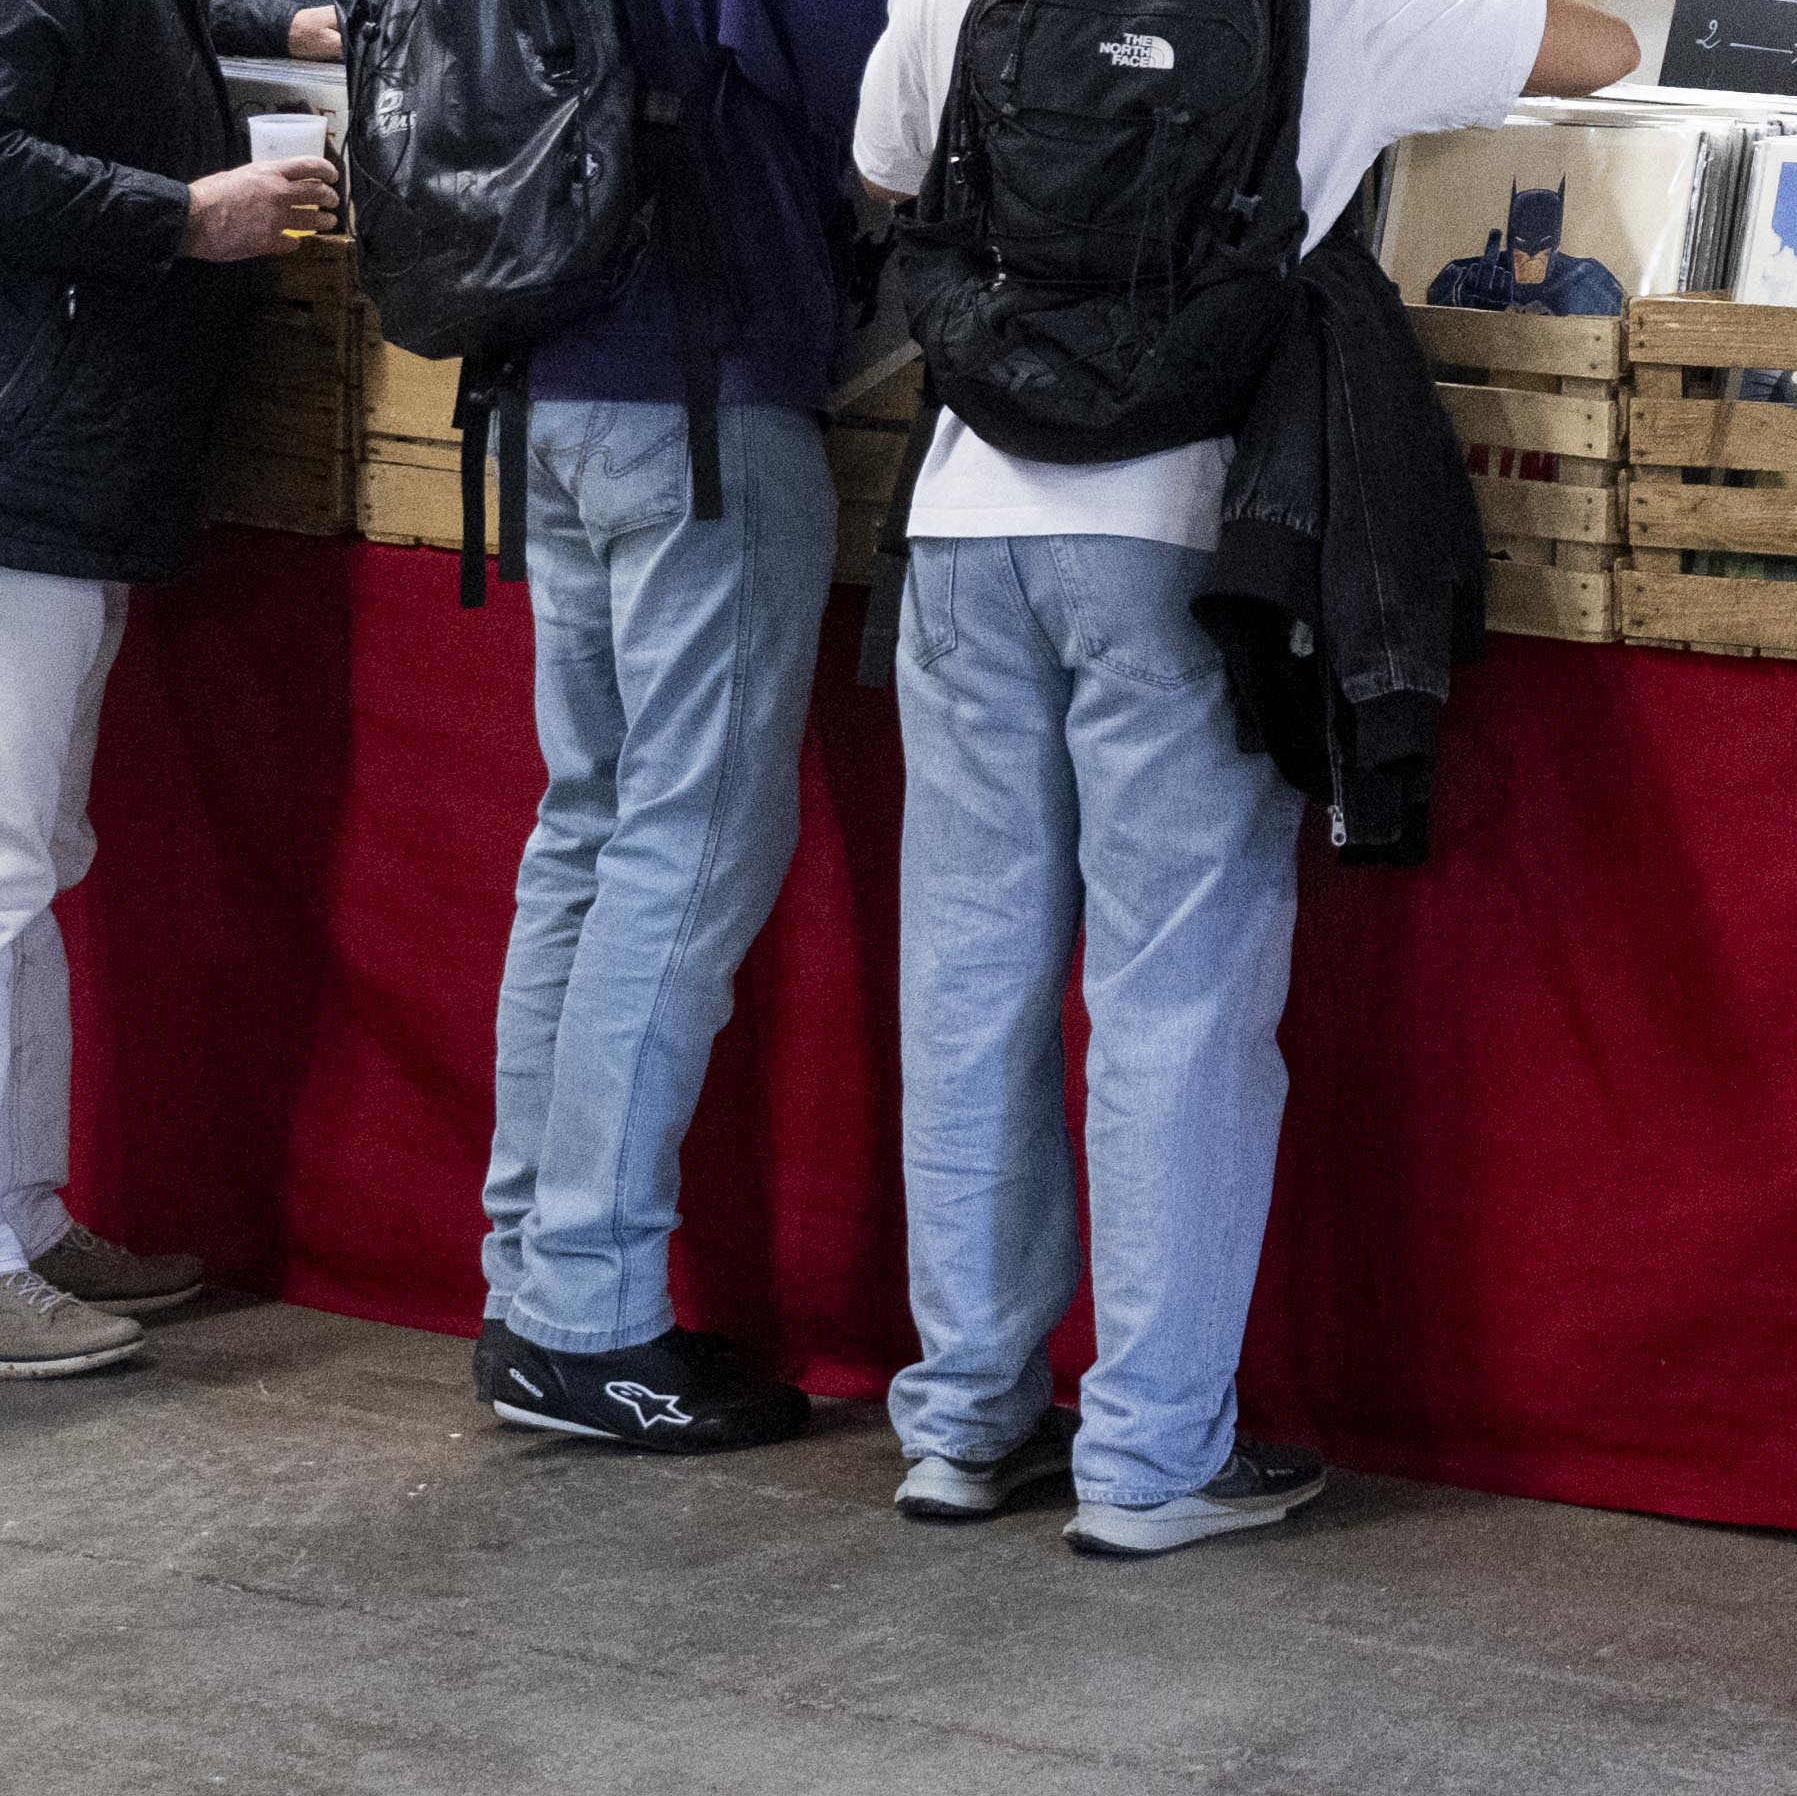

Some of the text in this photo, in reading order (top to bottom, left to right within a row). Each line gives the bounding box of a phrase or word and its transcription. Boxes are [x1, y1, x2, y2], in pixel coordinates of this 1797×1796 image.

[1123, 32, 1153, 46] THE
[1696, 20, 1722, 51] 2
[1099, 42, 1152, 56] NORTH
[1111, 54, 1151, 67] FACE
